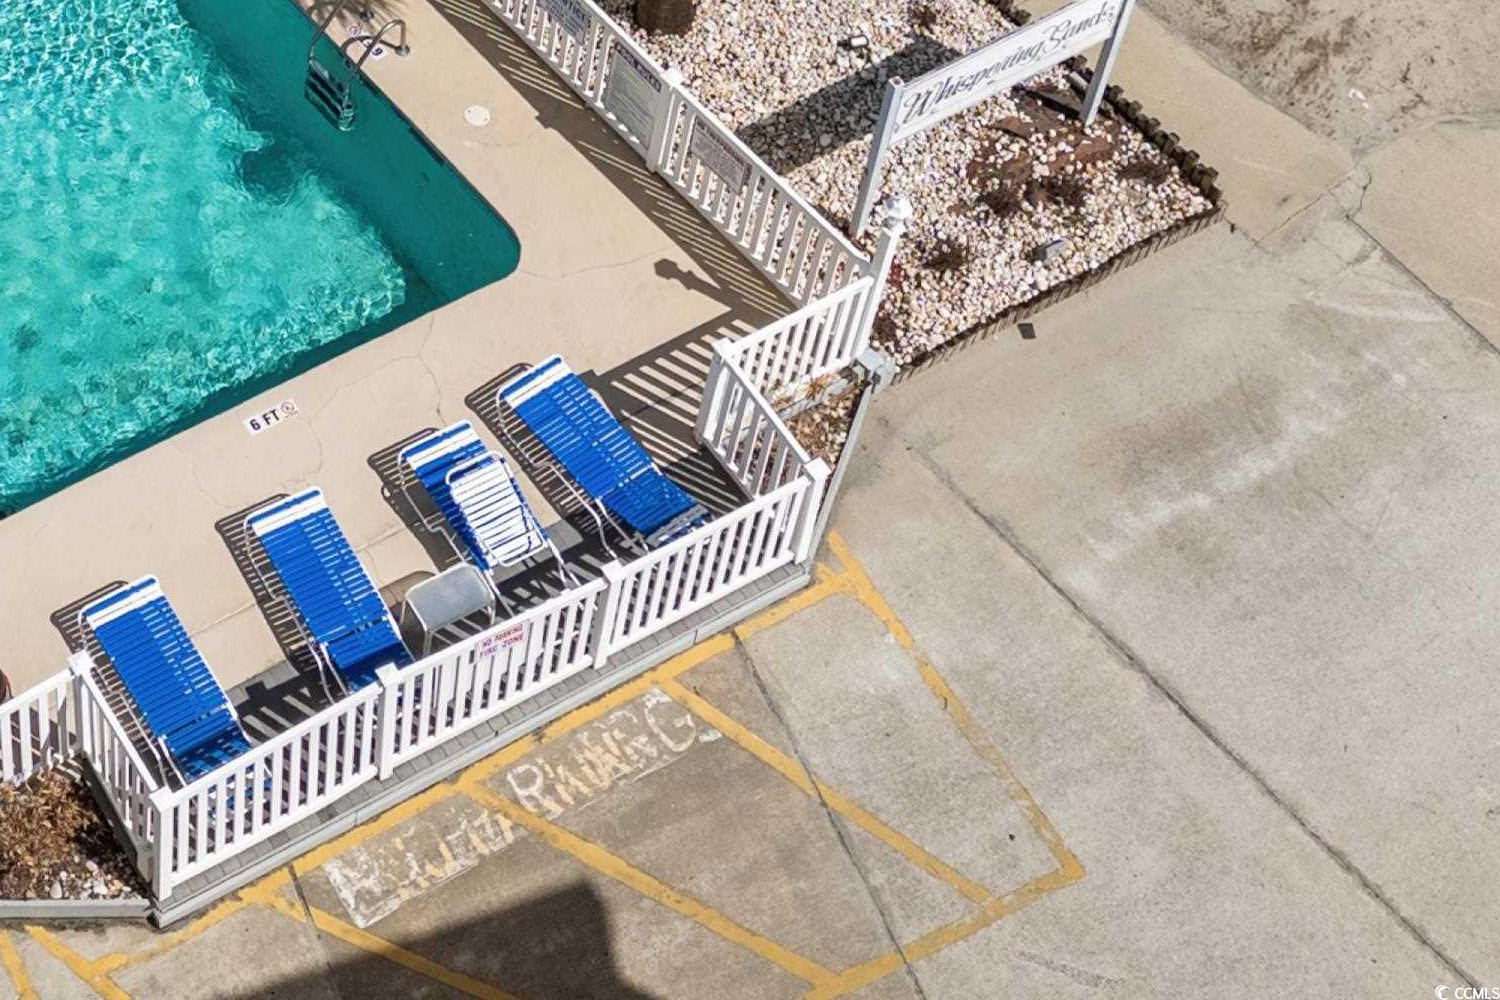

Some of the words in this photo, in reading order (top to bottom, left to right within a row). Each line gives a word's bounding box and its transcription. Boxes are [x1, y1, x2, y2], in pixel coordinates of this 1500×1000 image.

[1041, 1, 1115, 53] Sands
[250, 419, 261, 431] 6
[262, 409, 279, 425] FT
